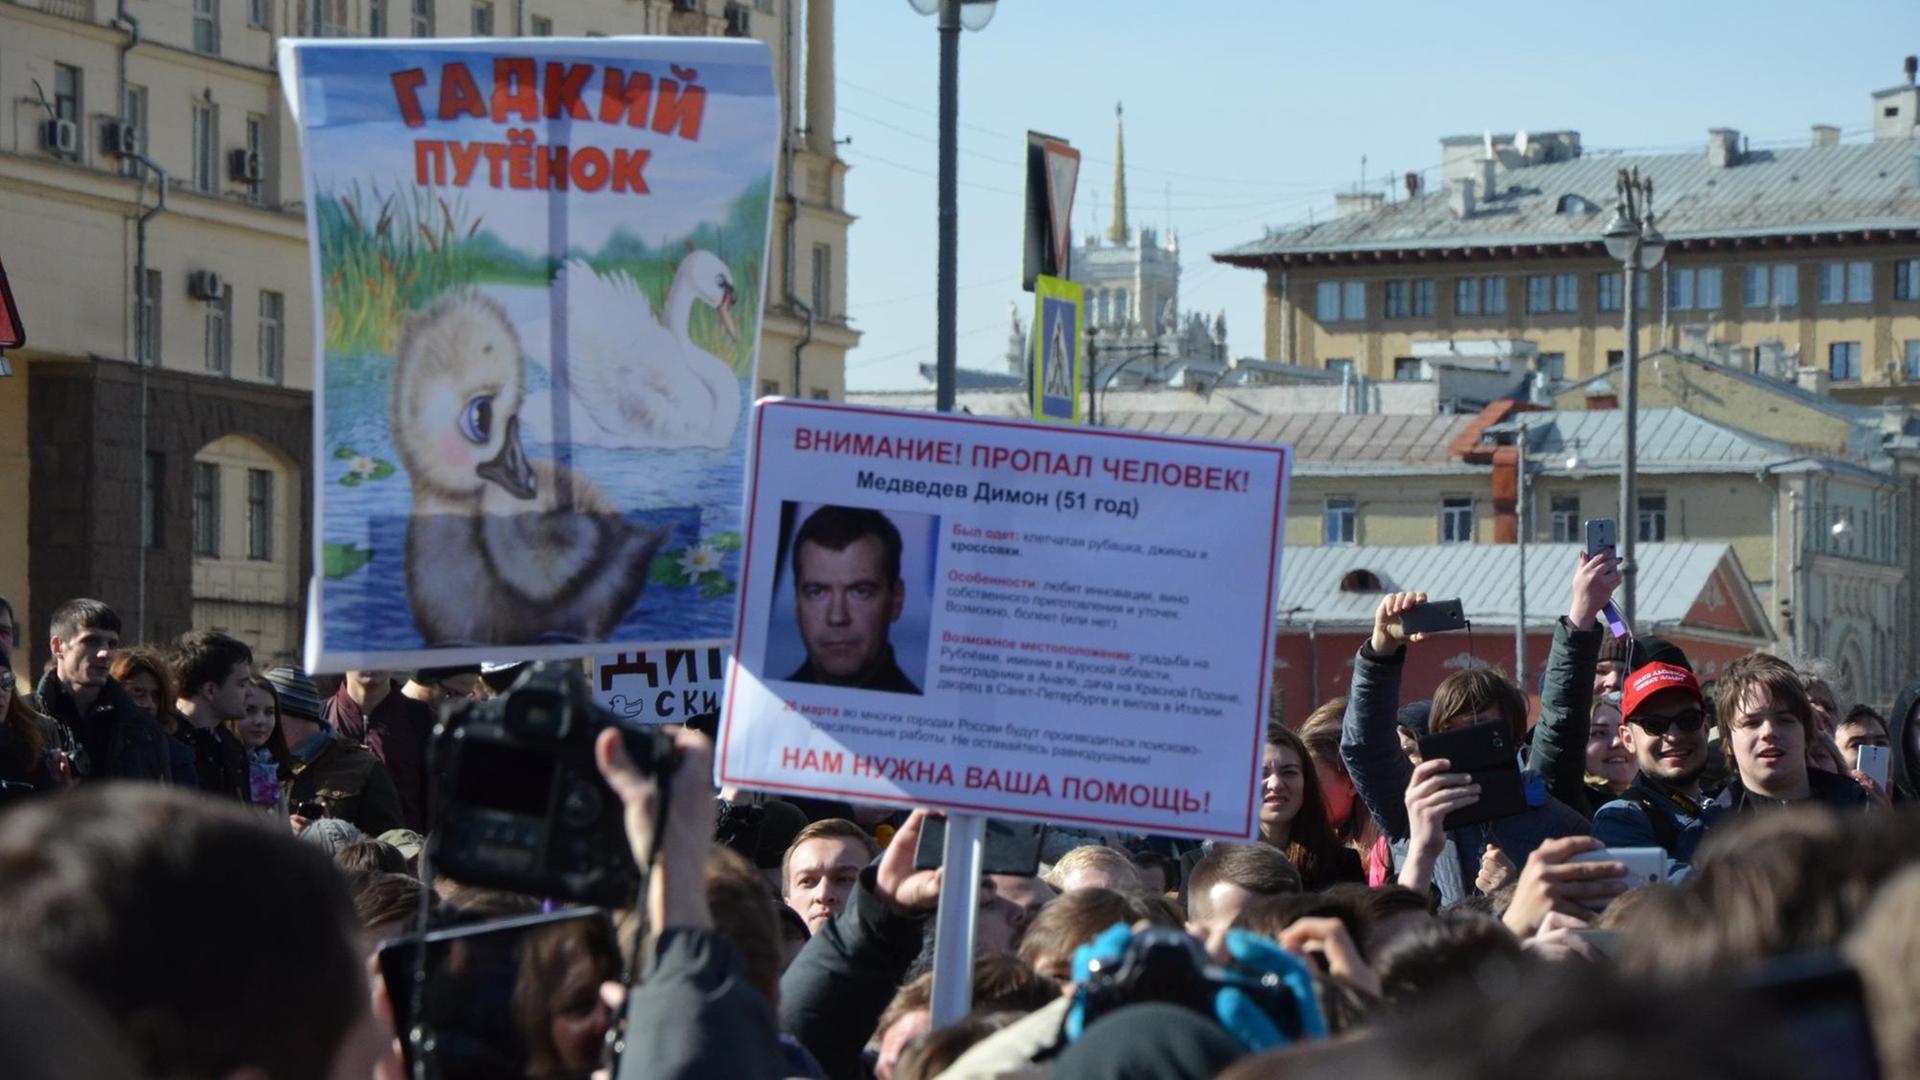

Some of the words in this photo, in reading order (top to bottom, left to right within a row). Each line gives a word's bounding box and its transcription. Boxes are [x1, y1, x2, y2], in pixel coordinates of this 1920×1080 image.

[390, 57, 707, 142] ГАДКИЙ
[414, 128, 651, 194] ПУТЁНОК
[793, 428, 962, 466] ВНИМАНИЕ!
[971, 444, 1095, 479] ПРОПАЛ
[1103, 457, 1250, 493] ЧЕЛОВЕК!
[856, 471, 969, 500] Медведев
[973, 482, 1050, 509] Димон
[1055, 488, 1088, 513] (51
[1093, 493, 1140, 518] год)
[952, 523, 987, 538] Был
[951, 540, 1023, 559] кроссовки.
[948, 570, 1040, 591] Особенности:
[1043, 580, 1082, 594] любит
[945, 601, 1012, 620] Возможно,
[1015, 608, 1058, 623] болеет
[1061, 612, 1087, 628] (или
[947, 585, 1030, 603] собственного
[1032, 595, 1124, 616] приготовления
[1127, 604, 1135, 614] и
[942, 631, 1016, 650] Возможное
[1139, 651, 1190, 670] усадьба
[1193, 658, 1210, 668] на
[1006, 656, 1053, 668] имение
[1056, 660, 1064, 669] в
[1067, 659, 1116, 677] Курской
[938, 679, 983, 695] дворец
[986, 683, 994, 693] в
[996, 683, 1108, 708] Санкт-Петербурге
[1111, 696, 1120, 706] и
[1164, 702, 1172, 711] в
[1028, 672, 1035, 682] в
[1083, 678, 1113, 692] дача
[1116, 681, 1132, 692] на
[1135, 682, 1187, 700] Красной
[800, 704, 840, 720] марта
[842, 708, 857, 718] во
[860, 711, 903, 723] многих
[906, 716, 955, 732] городах
[958, 719, 1003, 736] России
[1006, 723, 1039, 740] будут
[1043, 729, 1135, 750] производиться
[951, 734, 969, 746] Не
[781, 747, 845, 774] НАМ
[852, 755, 956, 786] НУЖНА
[965, 765, 1054, 796] ВАША
[1062, 776, 1212, 815] ПОМОЩЬ!
